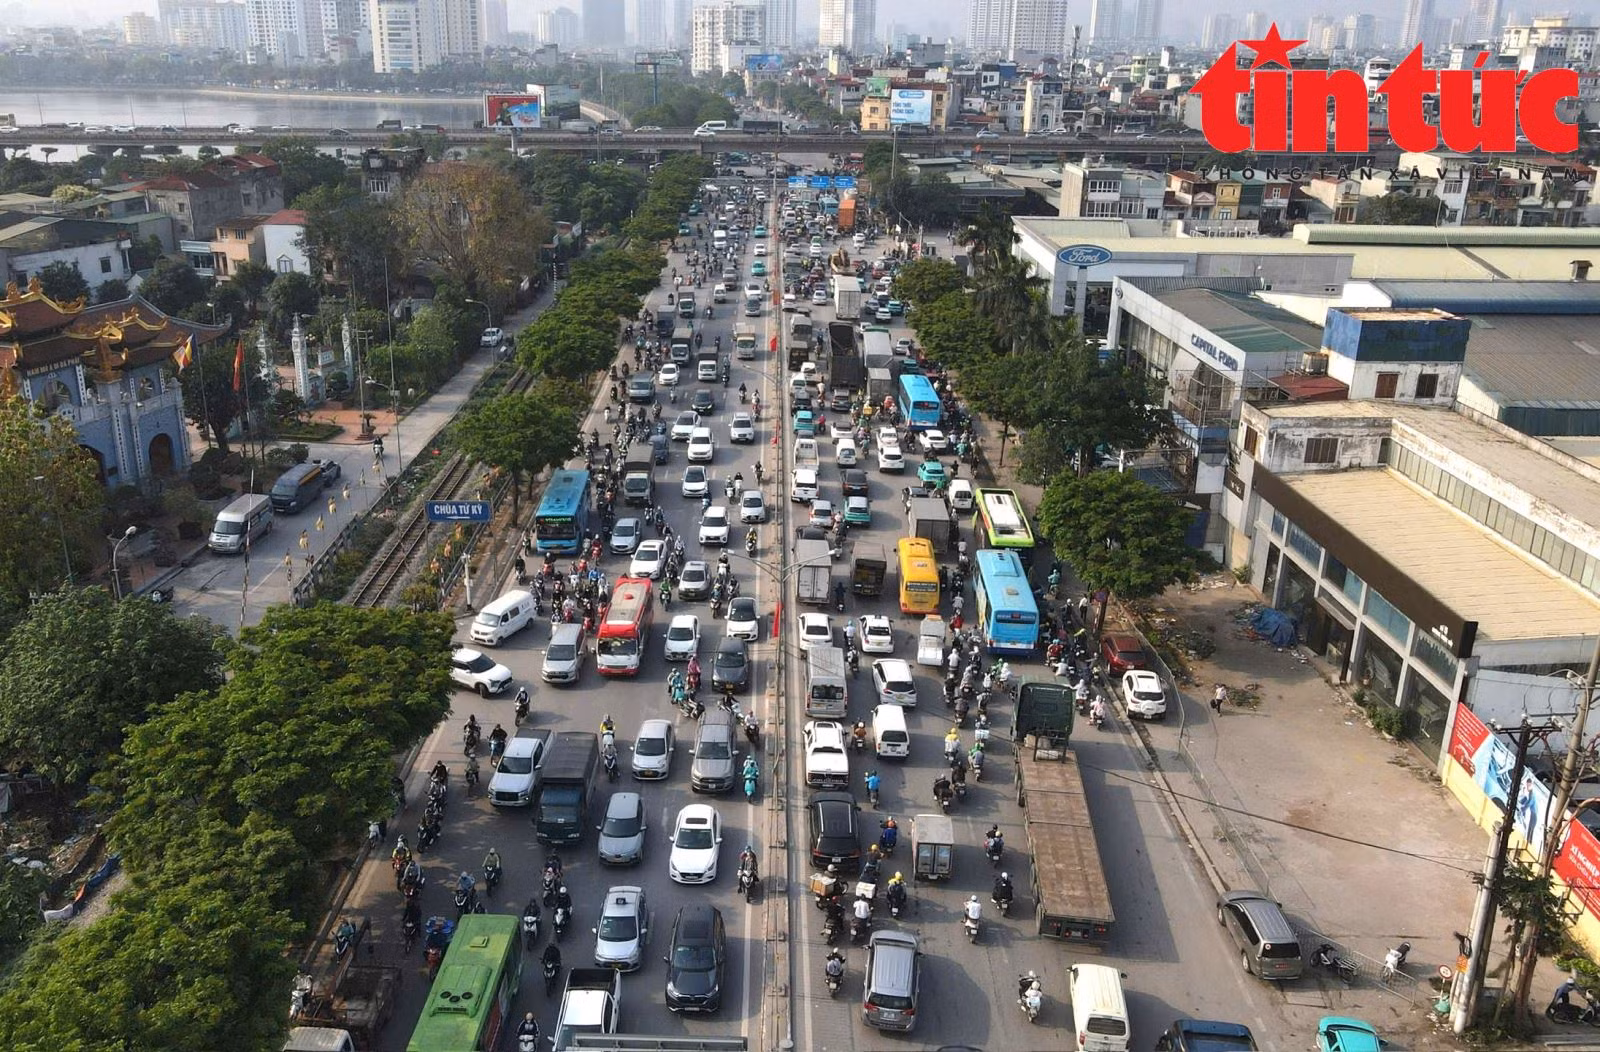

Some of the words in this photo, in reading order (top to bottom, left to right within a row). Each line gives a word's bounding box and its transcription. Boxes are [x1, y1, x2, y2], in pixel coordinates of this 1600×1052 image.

[1069, 249, 1100, 262] Ford
[1191, 333, 1217, 360] CAPITAL
[1219, 349, 1238, 371] FORD
[434, 503, 457, 515] CHÙA
